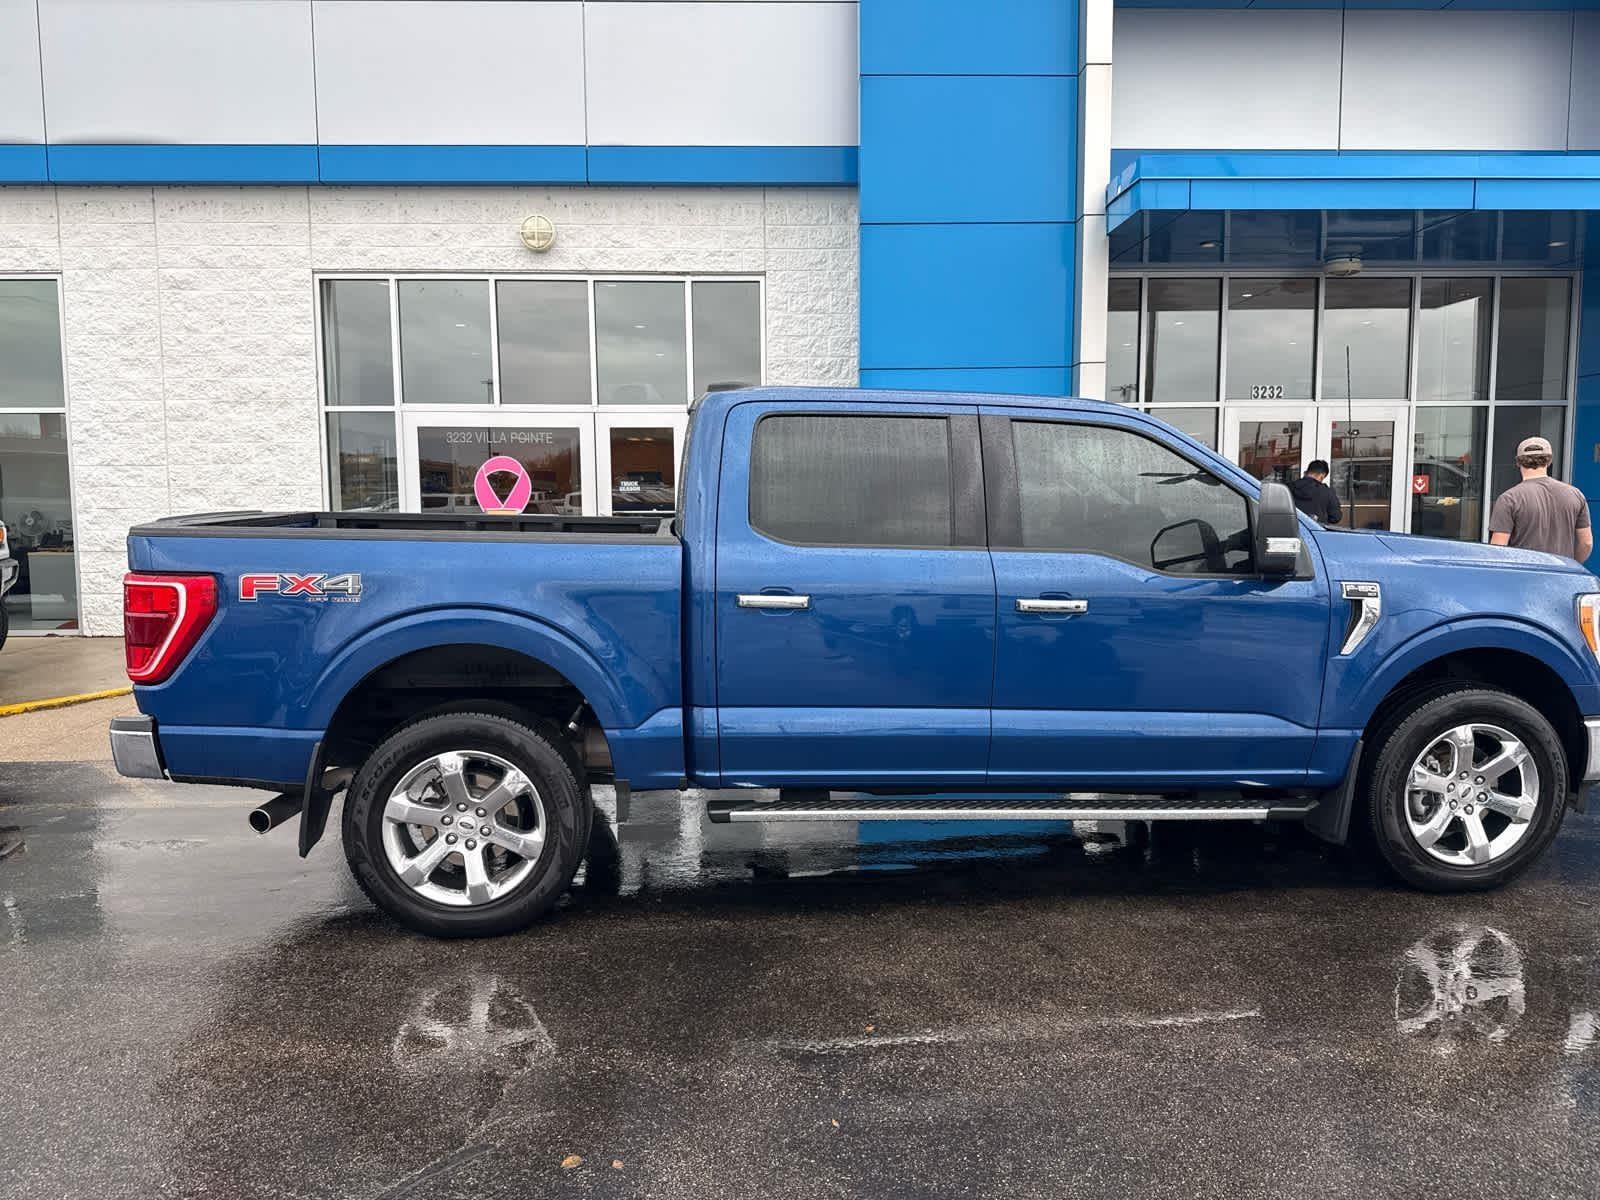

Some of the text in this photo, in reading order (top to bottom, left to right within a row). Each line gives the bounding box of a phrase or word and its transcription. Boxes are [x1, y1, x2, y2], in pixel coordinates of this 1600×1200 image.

[1253, 385, 1282, 399] 3232
[446, 431, 553, 444] 3232 VILLA POINTE
[239, 573, 362, 602] FX4
